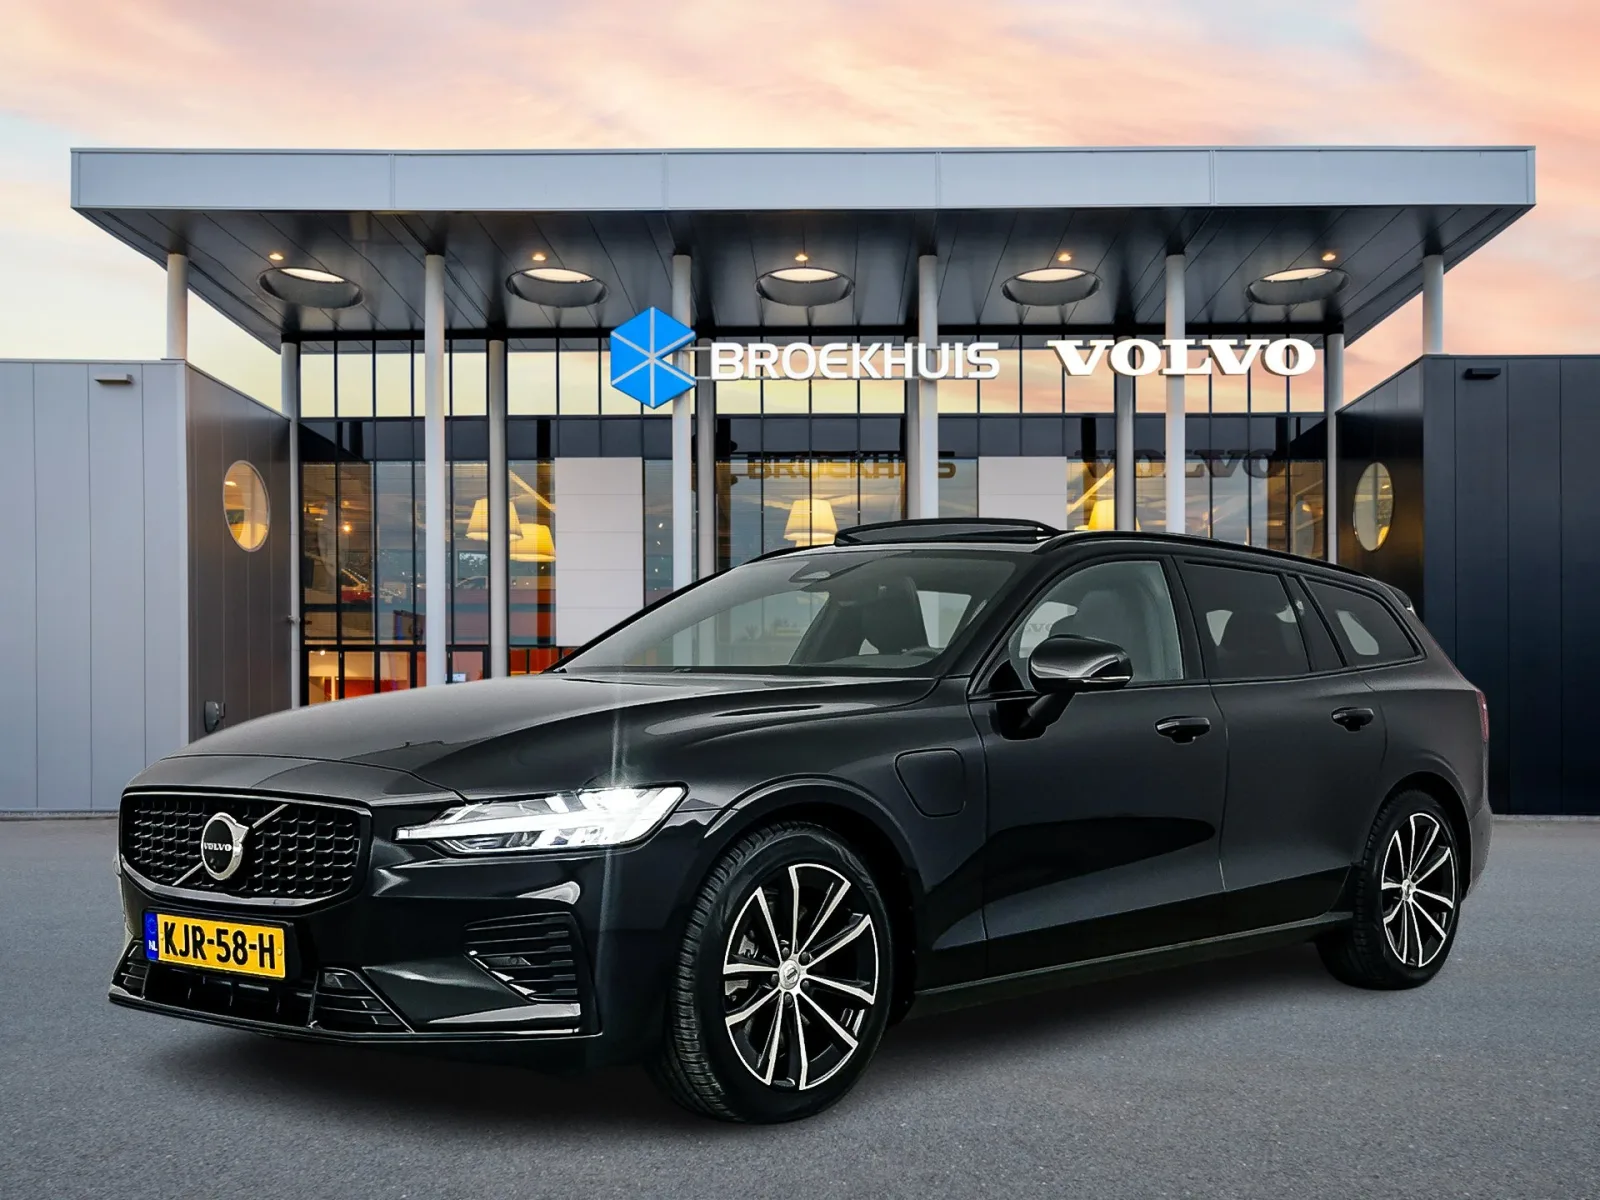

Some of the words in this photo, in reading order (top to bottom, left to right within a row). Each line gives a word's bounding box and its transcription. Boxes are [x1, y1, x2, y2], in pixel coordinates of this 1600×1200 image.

[711, 342, 1000, 380] BROEKHUIS
[1045, 338, 1316, 376] VOLVO
[747, 453, 956, 479] BROEKHS
[204, 842, 232, 851] VOLVO
[148, 940, 158, 951] NL
[164, 922, 275, 969] KJR-58-H
